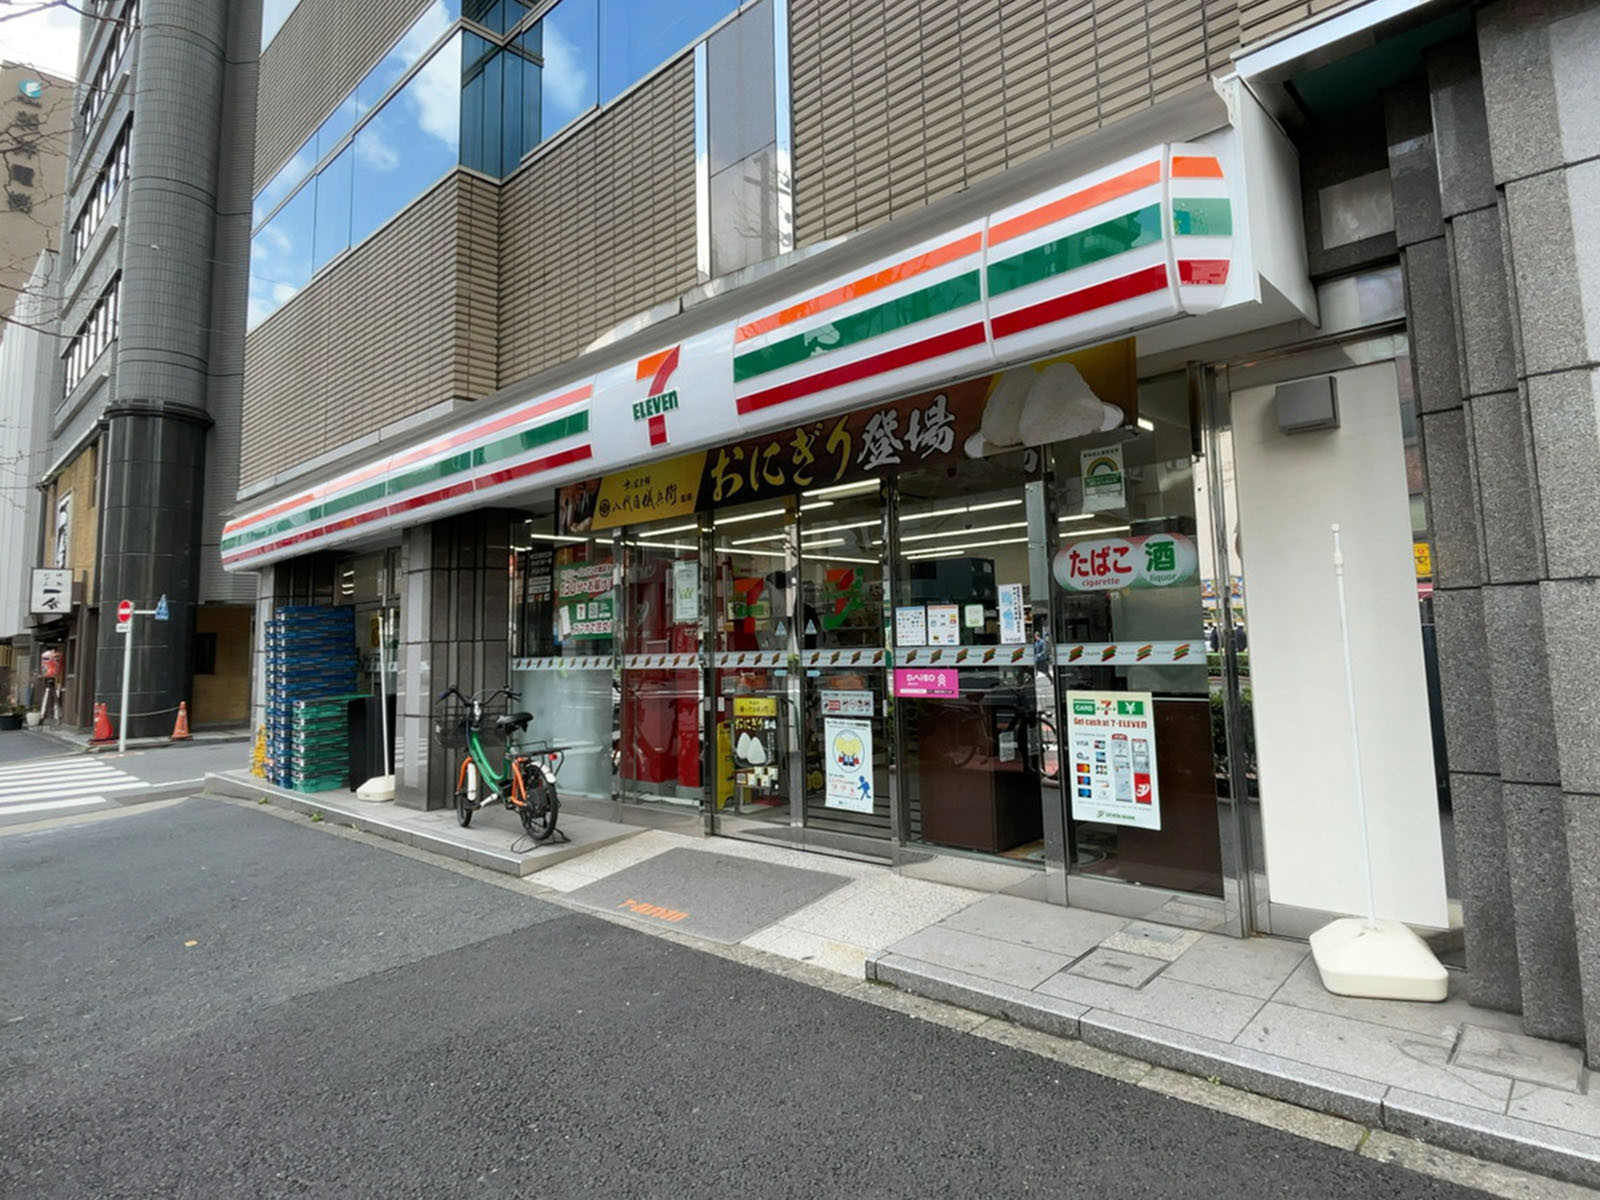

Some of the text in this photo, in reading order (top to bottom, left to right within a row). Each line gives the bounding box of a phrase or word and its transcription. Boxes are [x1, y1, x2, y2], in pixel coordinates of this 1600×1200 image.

[636, 344, 681, 446] 7
[711, 395, 956, 503] おにぎり登場
[1069, 546, 1133, 578] たばこ
[1145, 541, 1176, 572] 酒
[1081, 578, 1120, 589] cigarette
[1149, 573, 1177, 584] liquor
[1074, 717, 1085, 726] Get
[1086, 718, 1101, 727] cash
